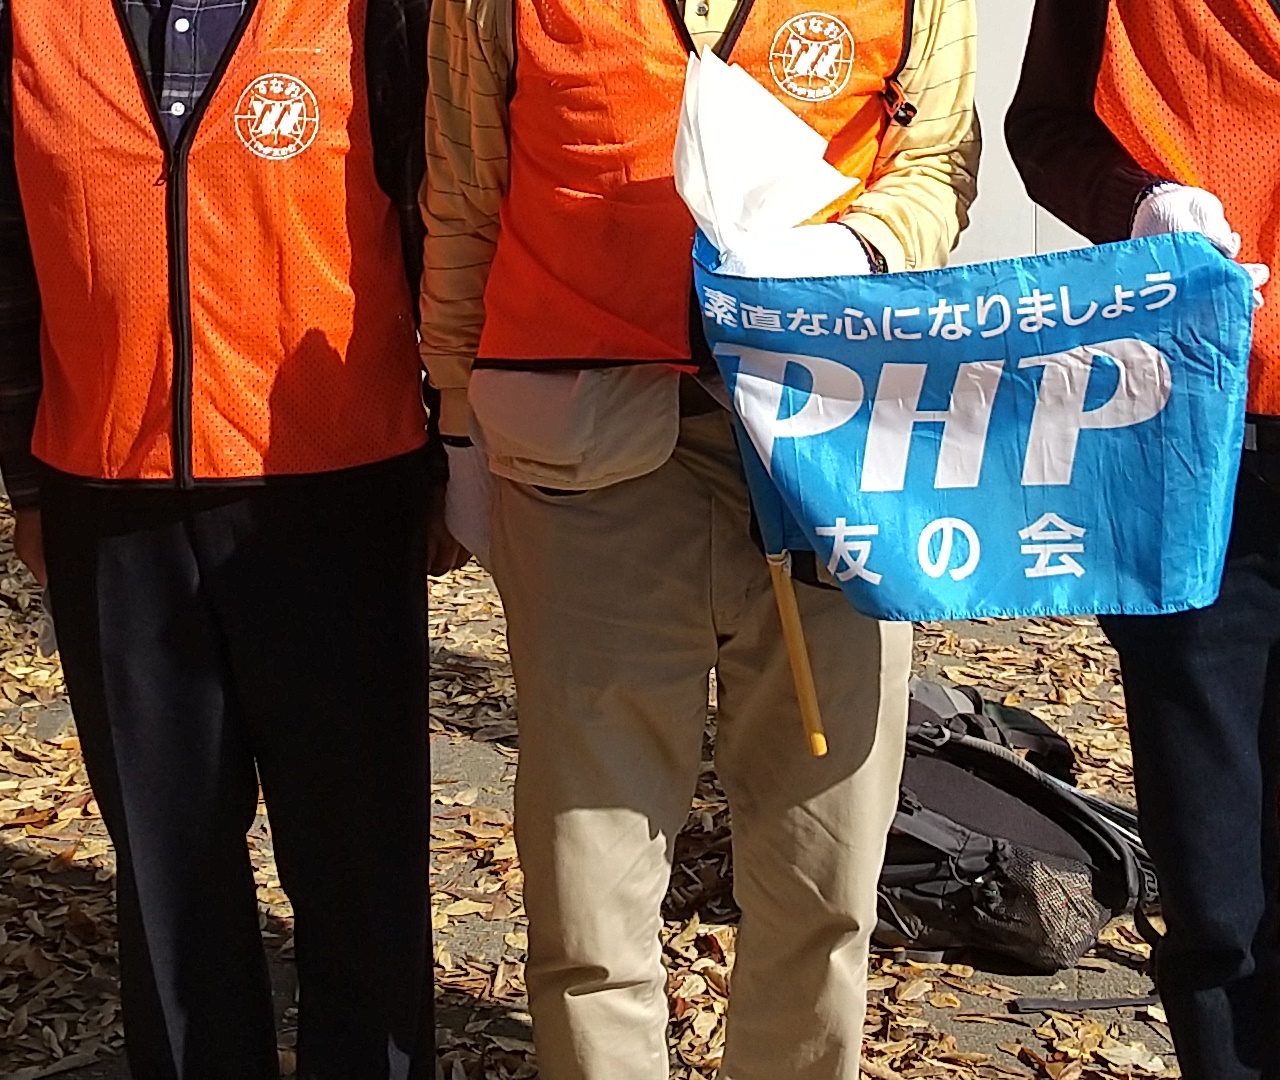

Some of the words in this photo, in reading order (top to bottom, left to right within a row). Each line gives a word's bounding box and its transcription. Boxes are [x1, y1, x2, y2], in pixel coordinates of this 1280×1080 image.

[793, 17, 840, 38] すなお
[255, 78, 301, 97] すなお
[702, 271, 1178, 343] 素直な心になりましょう
[713, 338, 1172, 493] PHP
[815, 512, 1086, 585] 友の会
